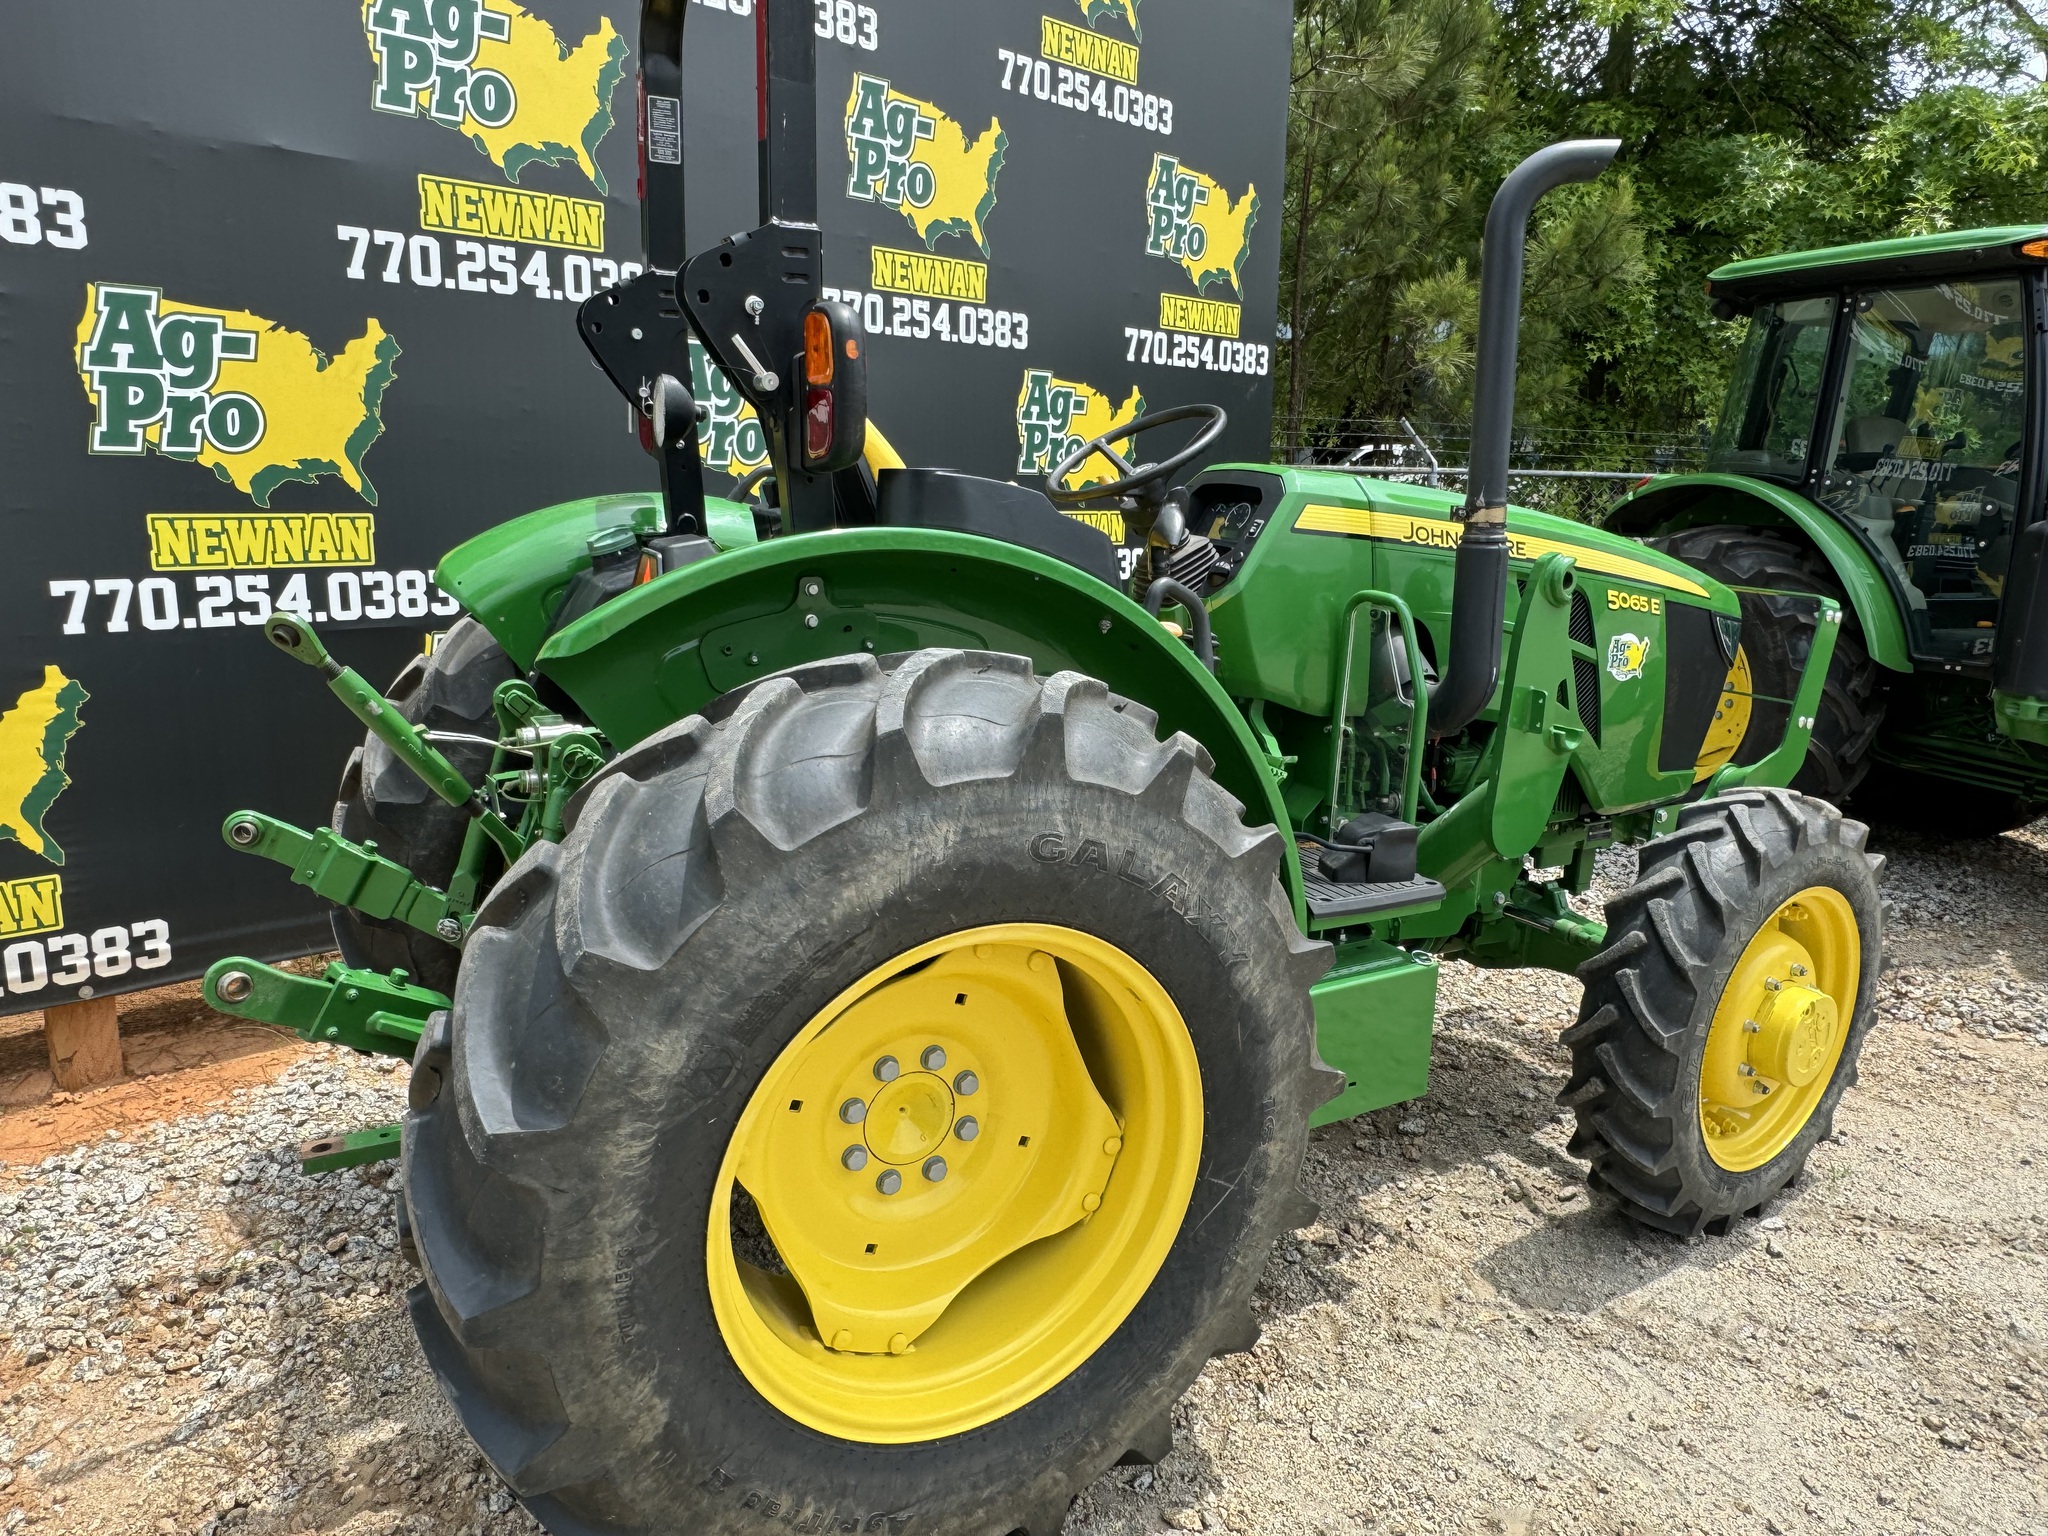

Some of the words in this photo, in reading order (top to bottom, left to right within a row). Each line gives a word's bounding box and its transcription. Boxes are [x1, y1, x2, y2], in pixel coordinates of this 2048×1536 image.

[374, 32, 517, 128] Pro
[1043, 19, 1138, 82] NEWNAN
[847, 75, 936, 160] Ag-
[999, 48, 1173, 136] 770.254.0383
[849, 137, 936, 208] Pro
[1150, 155, 1209, 222] Ag-
[421, 178, 602, 249] NEWNAN
[1147, 205, 1207, 261] Pro
[874, 249, 986, 301] NEWNAN
[82, 286, 257, 391] Ag-
[1162, 296, 1239, 336] NEWNAN
[1124, 327, 1269, 376] 770.254.0383
[93, 367, 264, 452] Pro
[1019, 372, 1087, 434] Ag-
[151, 517, 373, 568] NEWNAN
[1402, 521, 1459, 549] JOHN
[49, 568, 460, 635] 770.254.0383
[1609, 654, 1630, 670] Pro
[1028, 830, 1250, 968] GALAXY
